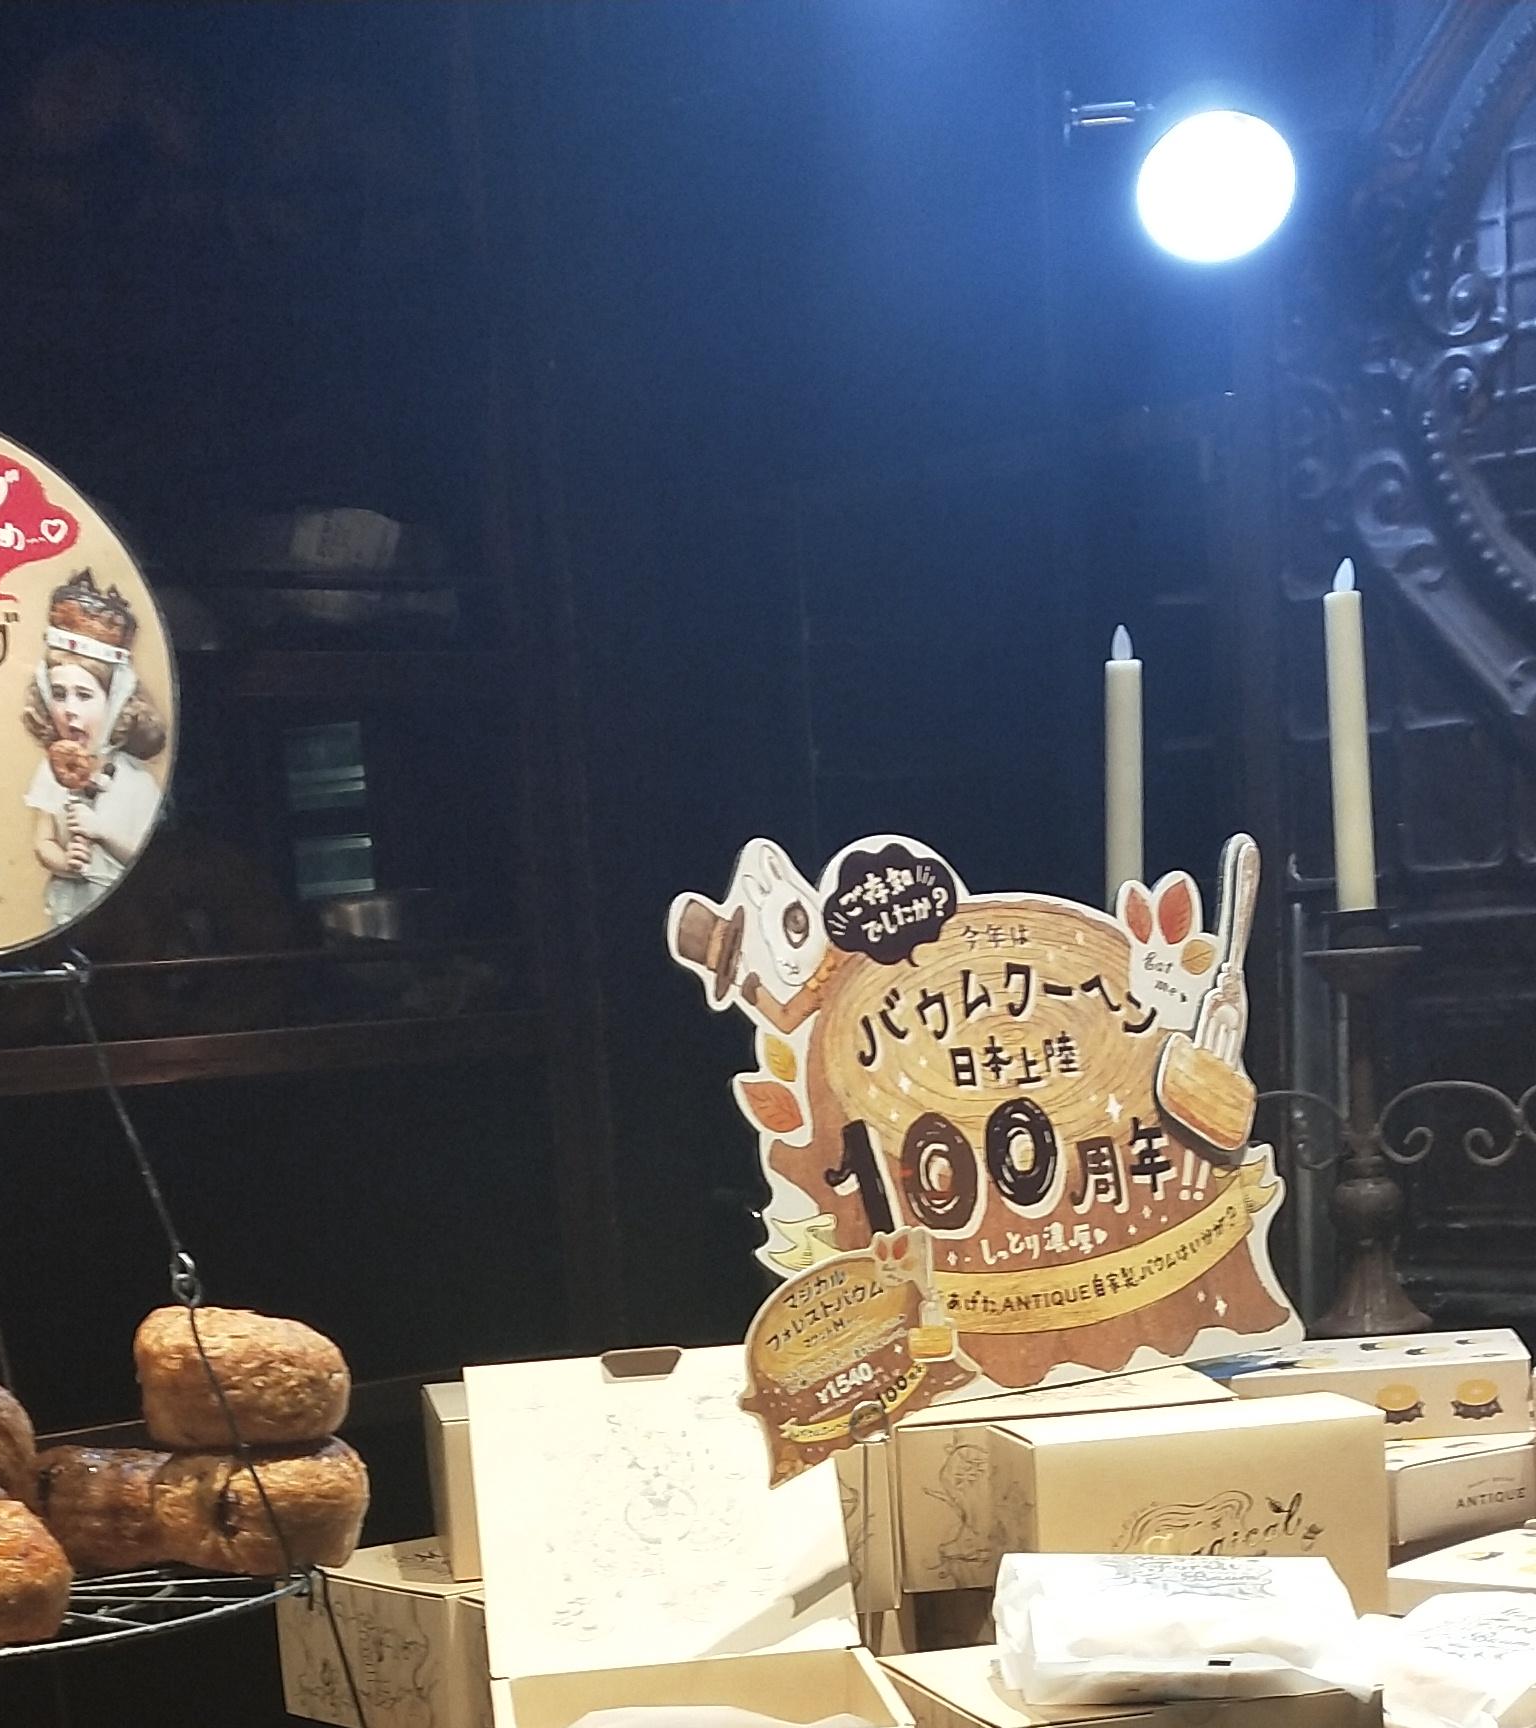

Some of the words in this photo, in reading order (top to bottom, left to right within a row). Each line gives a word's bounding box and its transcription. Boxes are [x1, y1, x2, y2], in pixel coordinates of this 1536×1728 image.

[838, 865, 914, 918] ご存知
[857, 961, 1158, 1068] バウムクーヘン
[949, 1030, 1080, 1088] 日本上陸
[765, 1281, 884, 1352] フォレストバウム
[783, 1270, 848, 1309] マジカル
